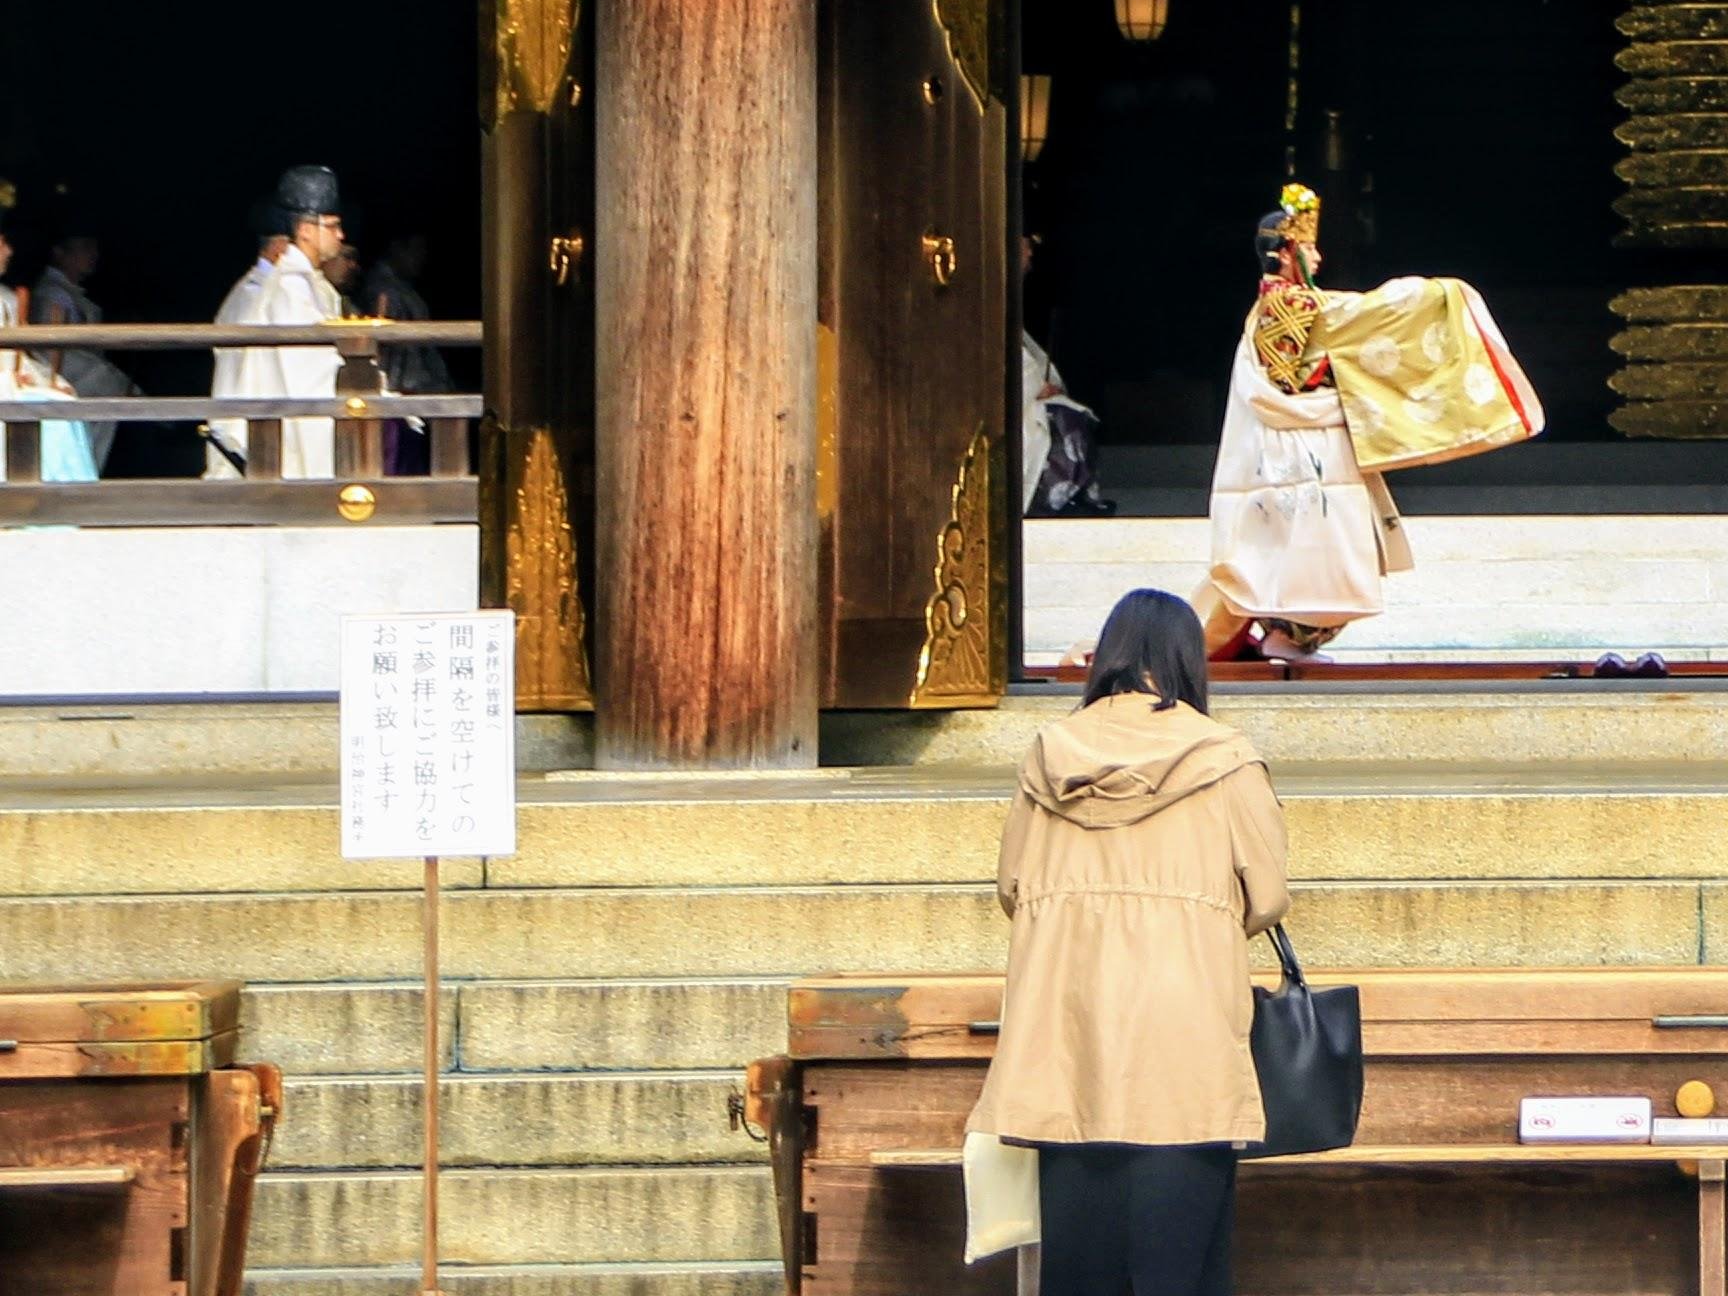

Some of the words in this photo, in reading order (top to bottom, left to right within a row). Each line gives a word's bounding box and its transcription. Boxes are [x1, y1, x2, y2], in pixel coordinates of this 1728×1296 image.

[373, 624, 398, 812] お願い致します
[412, 621, 437, 841] ご参拝にご協力を
[450, 625, 475, 833] 間隔を空けての
